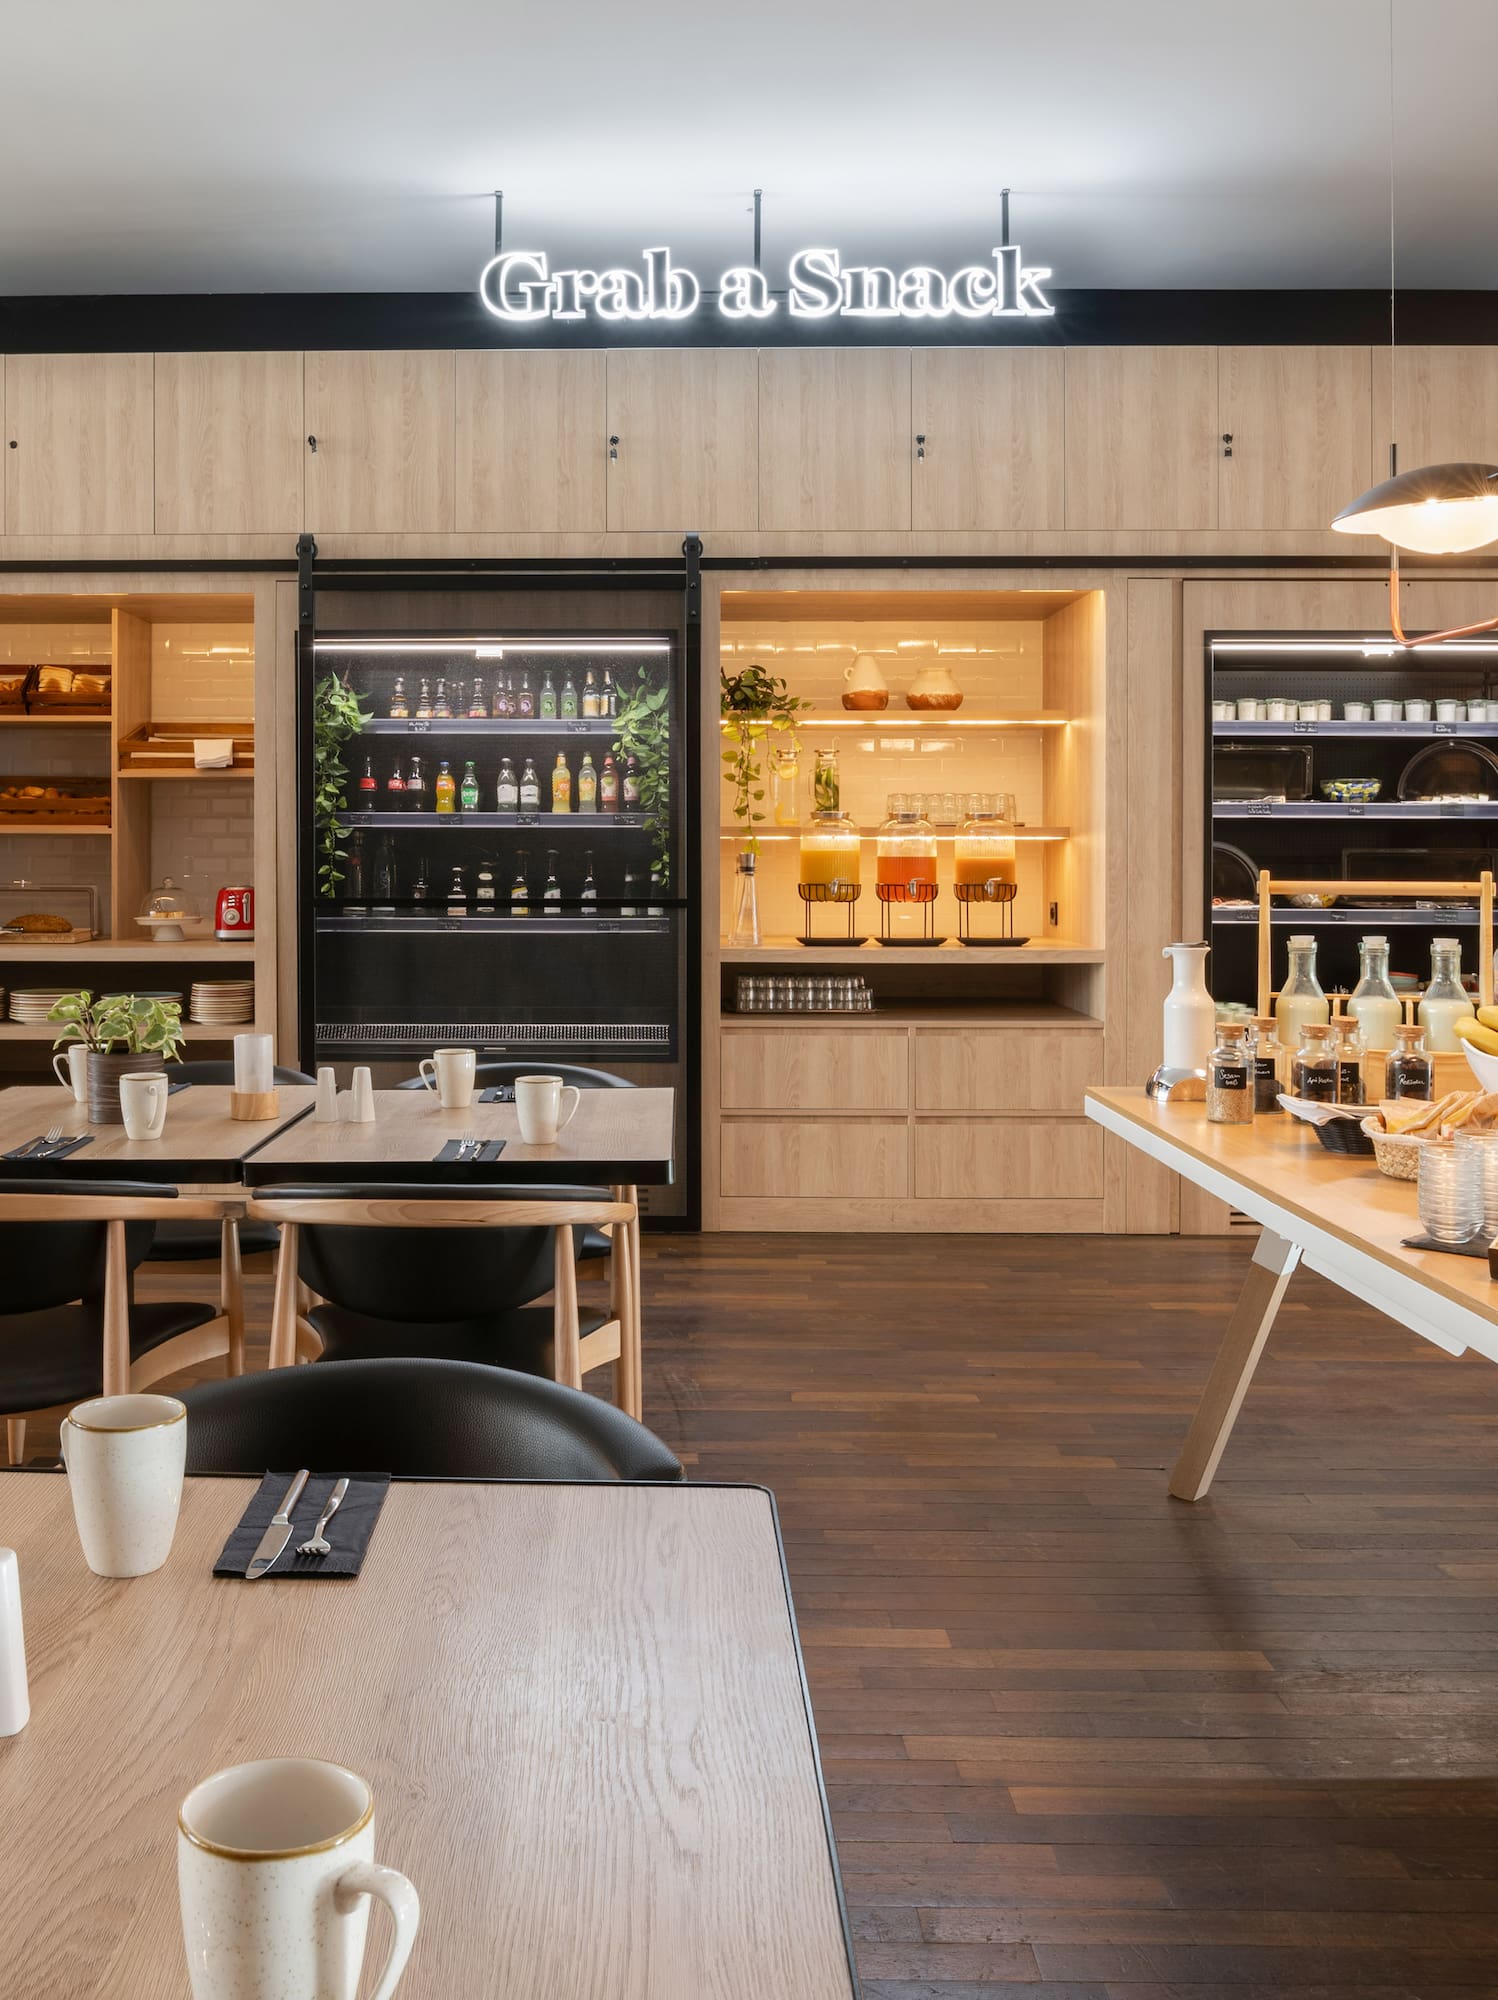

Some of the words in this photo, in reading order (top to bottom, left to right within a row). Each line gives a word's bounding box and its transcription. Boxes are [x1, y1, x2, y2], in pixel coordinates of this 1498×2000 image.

[480, 247, 699, 321] Grab
[719, 267, 777, 319] a
[788, 246, 1056, 318] Snack
